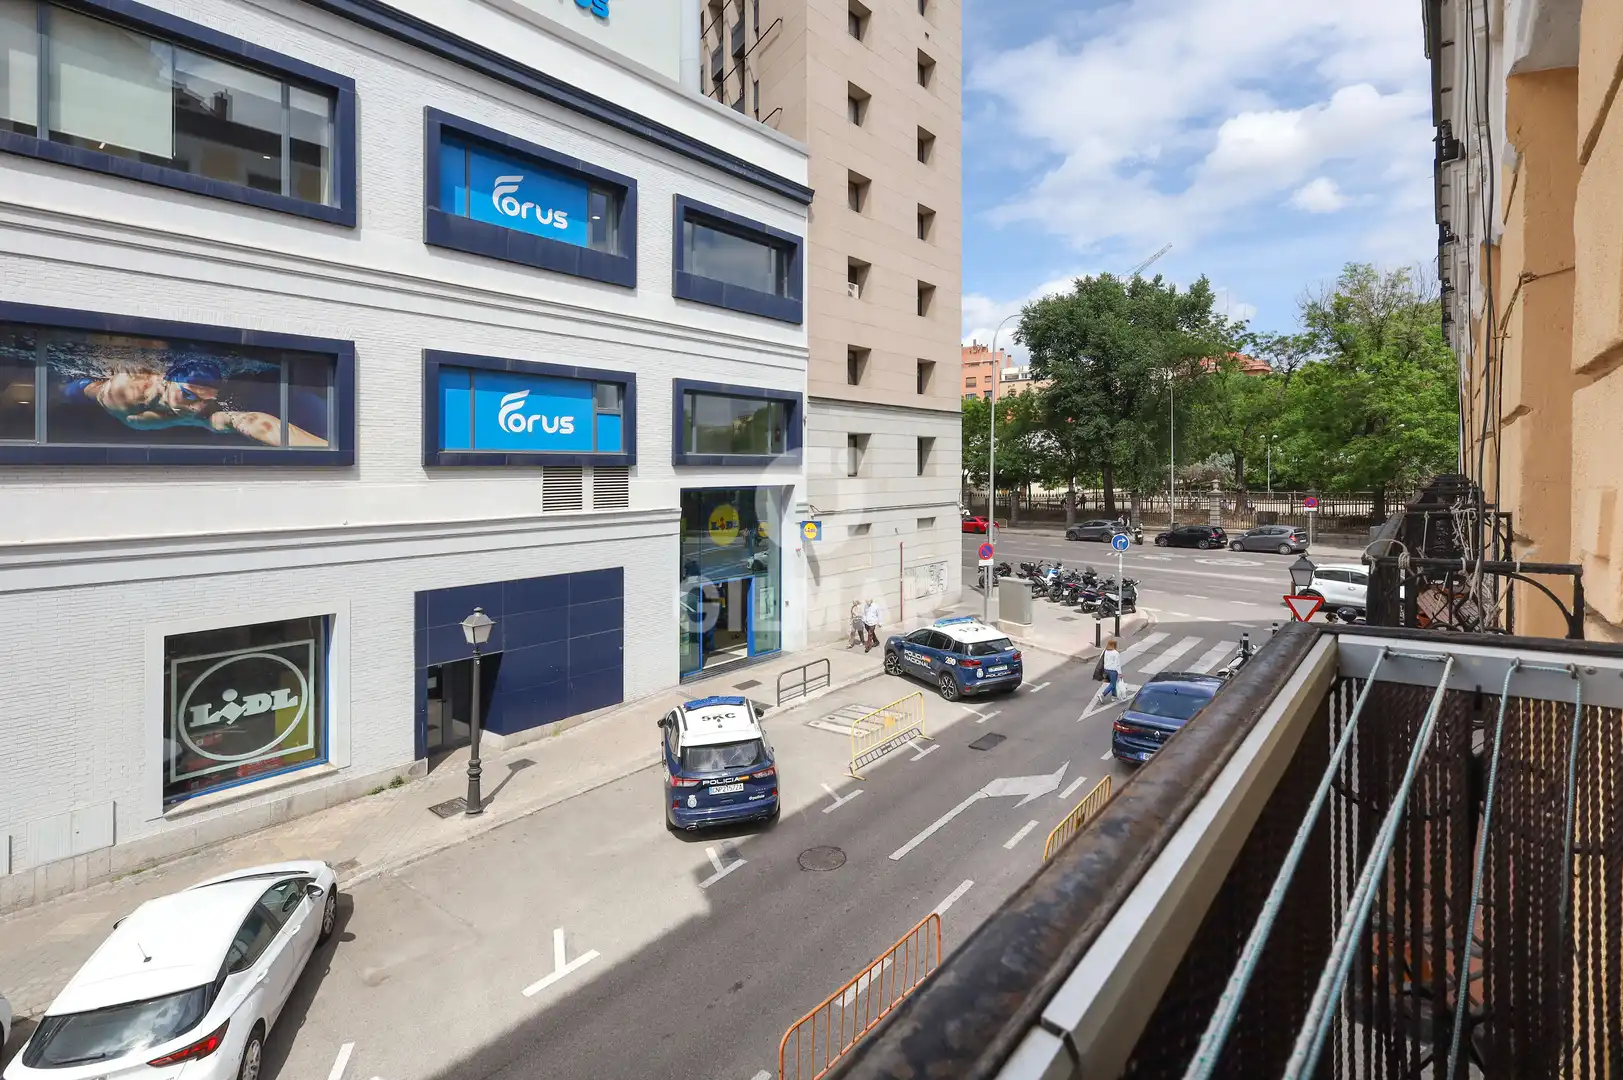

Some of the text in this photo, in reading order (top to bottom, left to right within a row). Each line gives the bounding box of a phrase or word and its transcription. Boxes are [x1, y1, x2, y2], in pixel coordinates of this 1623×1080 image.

[492, 175, 568, 230] Forus
[498, 389, 575, 435] Forus
[904, 650, 925, 662] POLICIA
[904, 655, 931, 669] NACIONAL
[703, 777, 740, 785] POLICIA
